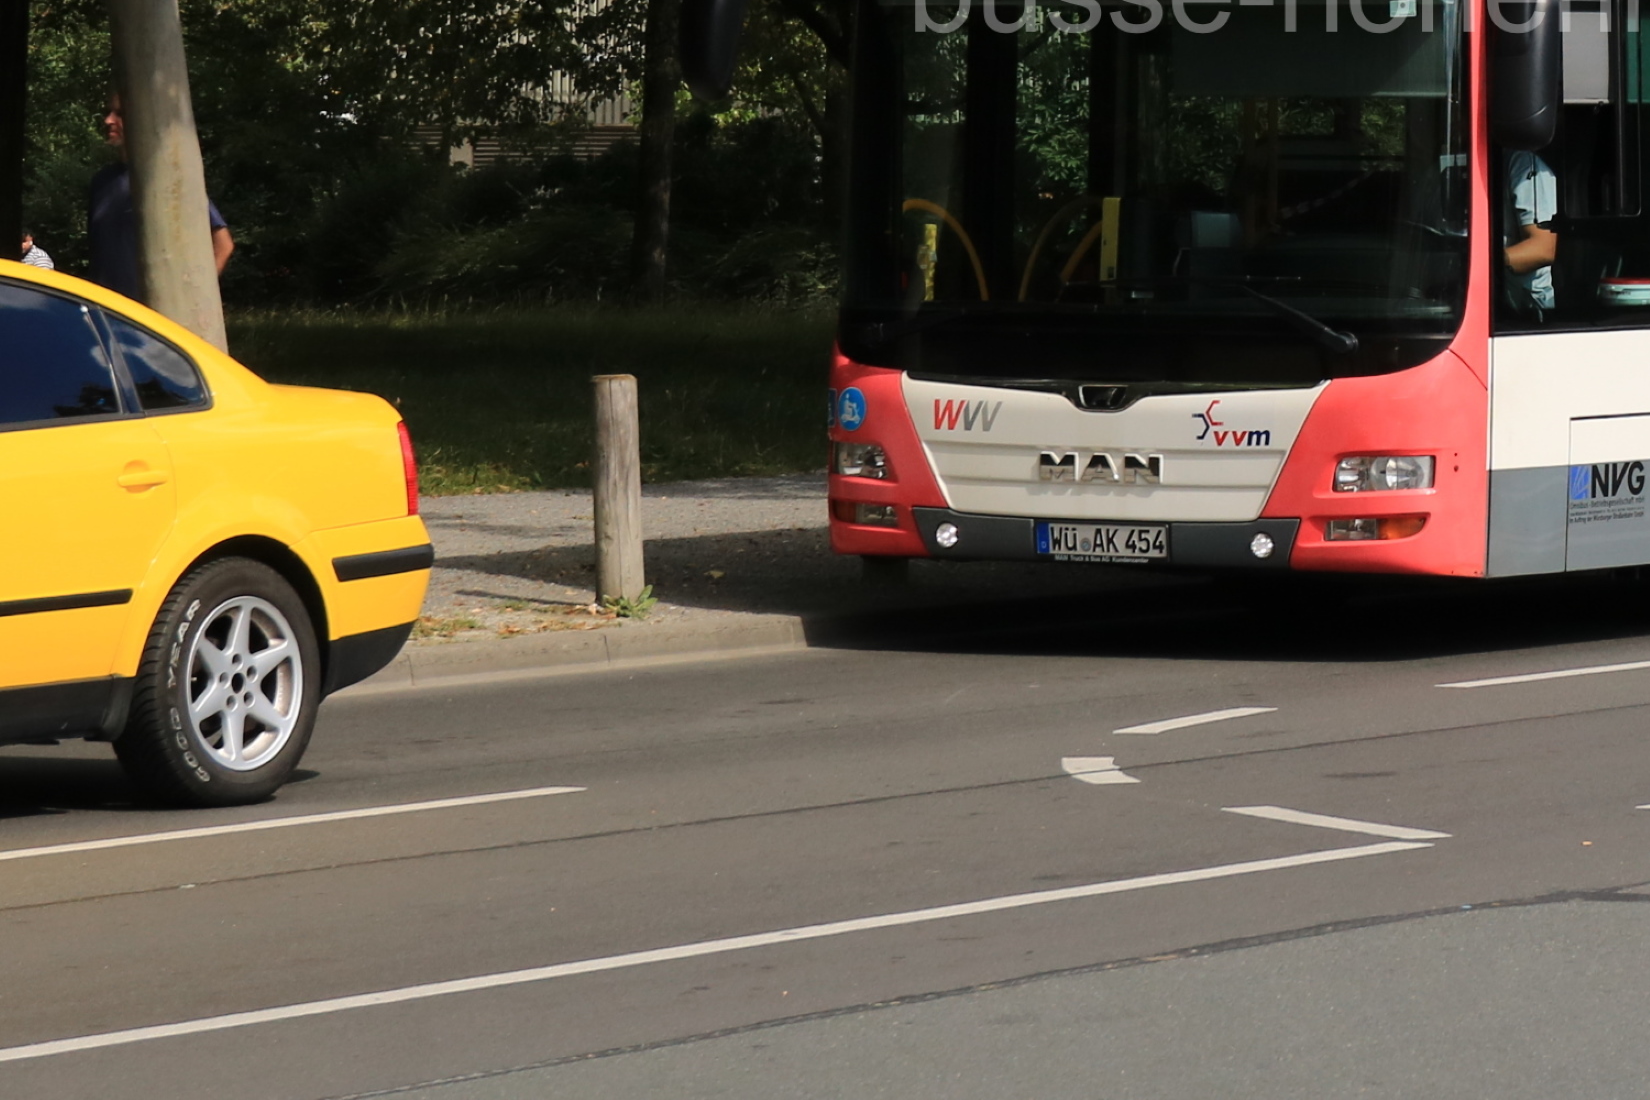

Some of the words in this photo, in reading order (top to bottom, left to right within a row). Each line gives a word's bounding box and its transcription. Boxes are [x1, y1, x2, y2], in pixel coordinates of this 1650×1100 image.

[1213, 428, 1271, 447] vvm
[1038, 451, 1164, 485] MAN
[1591, 461, 1645, 498] NVG
[1050, 527, 1078, 552] WÜ
[1092, 528, 1119, 553] AK
[1125, 529, 1165, 554] 454
